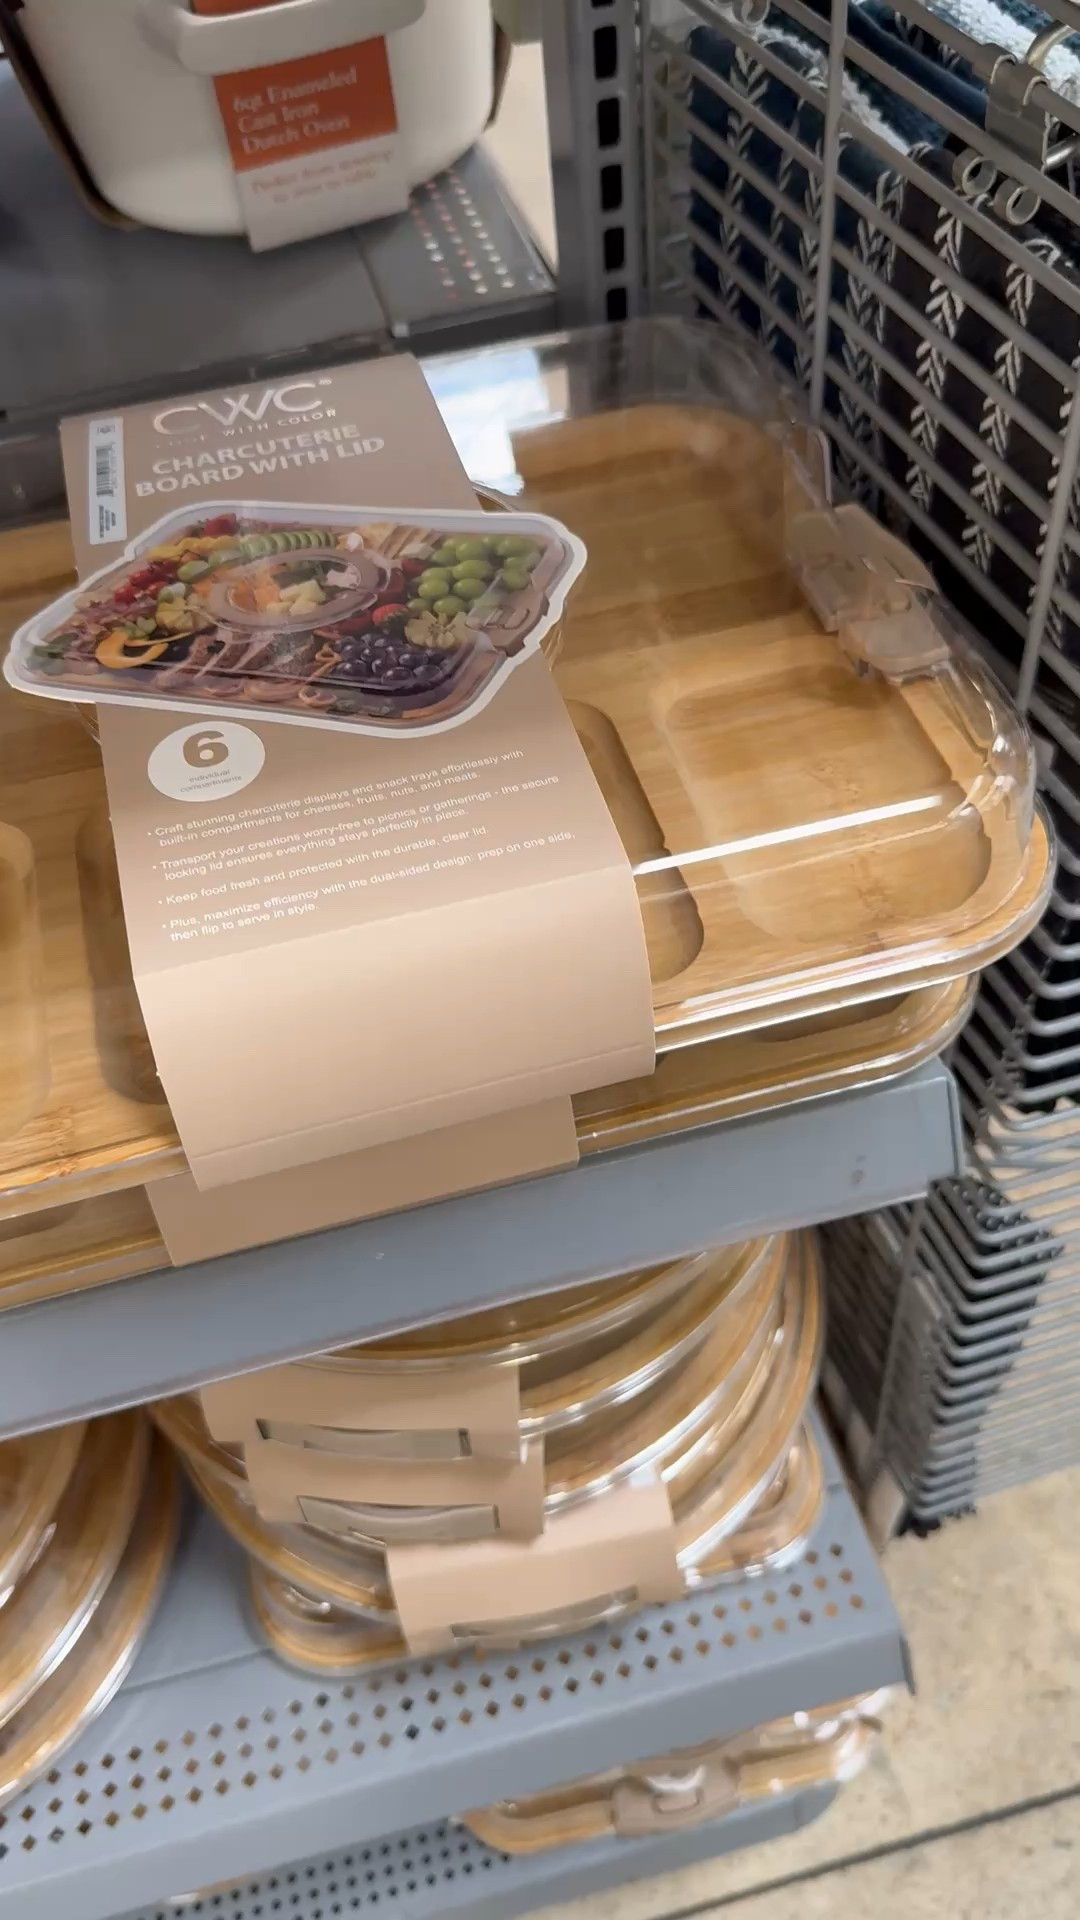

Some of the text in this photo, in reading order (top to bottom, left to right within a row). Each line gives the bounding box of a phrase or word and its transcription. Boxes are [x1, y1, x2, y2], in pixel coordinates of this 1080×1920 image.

[267, 65, 357, 105] Enameled
[237, 102, 318, 133] Cast Iron
[242, 115, 350, 154] Dutch Oven
[136, 465, 243, 496] BOARD
[249, 447, 329, 474] WITH
[336, 437, 384, 458] LID
[152, 424, 360, 475] CHARCUTERIE
[183, 731, 229, 768] 6
[155, 750, 524, 836] Craft stunning charcuterie displays and snack trays effortlessly with
[180, 775, 243, 793] compartments
[189, 769, 231, 783] individual
[160, 832, 198, 847] built-in
[201, 814, 282, 838] compartments
[285, 810, 300, 820] for
[420, 779, 441, 791] and
[160, 850, 217, 869] Transport
[220, 845, 245, 858] your
[247, 833, 301, 851] creations
[303, 820, 361, 839] worry-free
[363, 816, 375, 826] to
[377, 808, 416, 825] picnics
[419, 804, 430, 813] or
[433, 790, 492, 812] gatherings
[501, 784, 519, 795] the
[521, 776, 559, 790] secure
[164, 865, 207, 880] locking
[209, 861, 224, 871] lid
[226, 851, 273, 867] ensures
[276, 837, 336, 857] everything
[338, 830, 368, 843] stays
[371, 818, 419, 837] perfectly
[422, 814, 432, 824] in
[166, 892, 198, 905] Keep
[200, 883, 227, 897] food
[230, 877, 260, 890] fresh
[263, 872, 285, 883] and
[288, 858, 343, 878] protected
[345, 852, 369, 865] with
[371, 848, 391, 859] the
[442, 831, 470, 843] clear
[170, 917, 200, 929] Plus,
[203, 902, 260, 921] maximize
[263, 889, 319, 908] efficiency
[320, 881, 346, 895] with
[348, 878, 368, 889] the
[370, 863, 431, 884] dual-sided
[477, 845, 504, 860] prep
[506, 842, 521, 853] on
[523, 837, 546, 849] one
[170, 929, 198, 941] then
[201, 924, 220, 936] flip
[222, 921, 234, 930] to
[237, 912, 270, 927] serve
[273, 908, 285, 919] in
